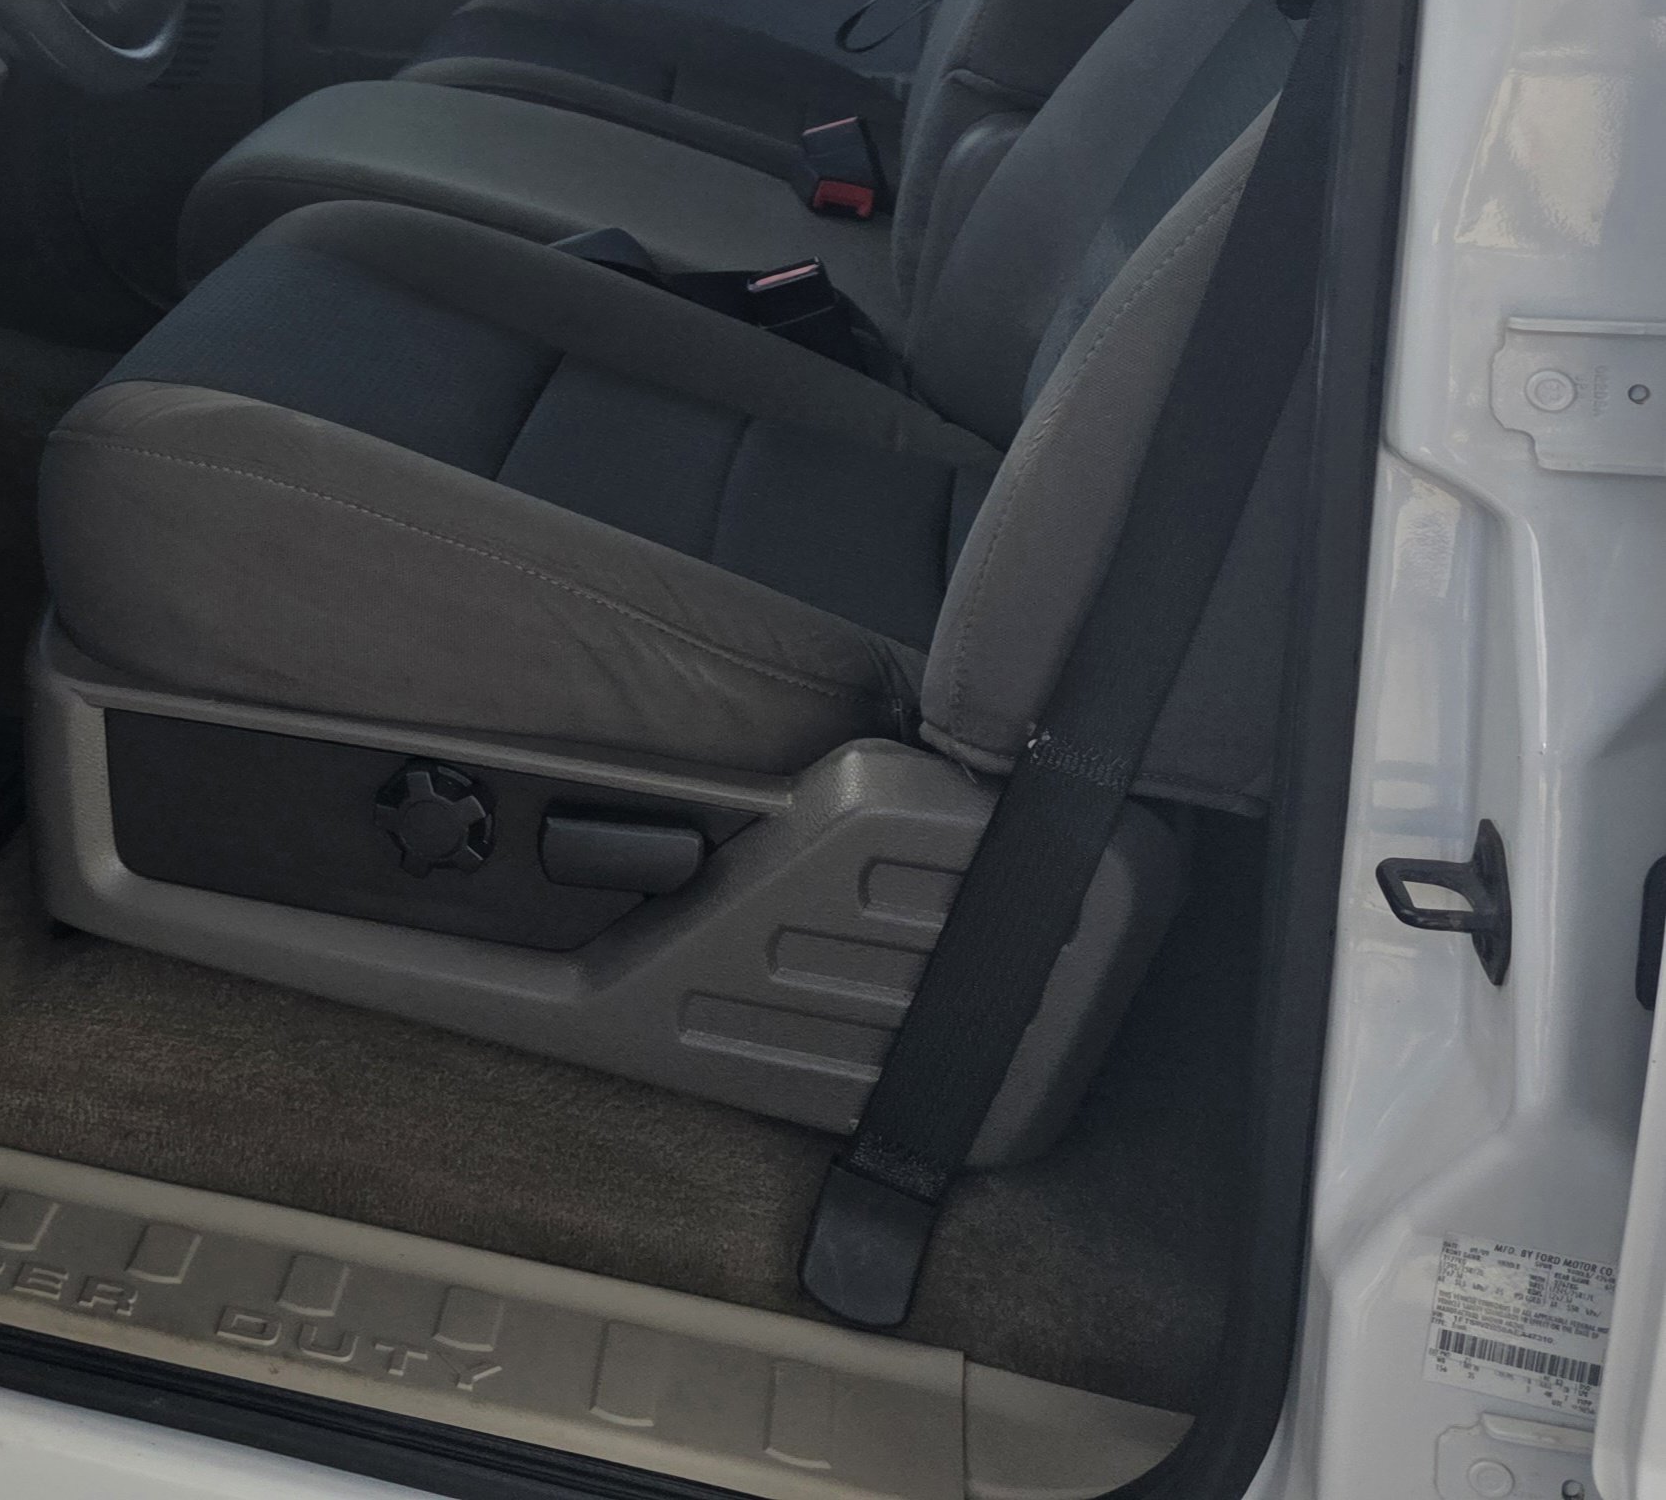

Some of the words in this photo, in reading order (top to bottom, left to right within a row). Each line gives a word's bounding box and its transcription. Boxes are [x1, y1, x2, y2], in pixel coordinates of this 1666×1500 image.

[1520, 1247, 1533, 1260] BY
[1535, 1251, 1561, 1266] FORD
[1562, 1256, 1596, 1274] MOTOR
[215, 1306, 503, 1391] DUTY
